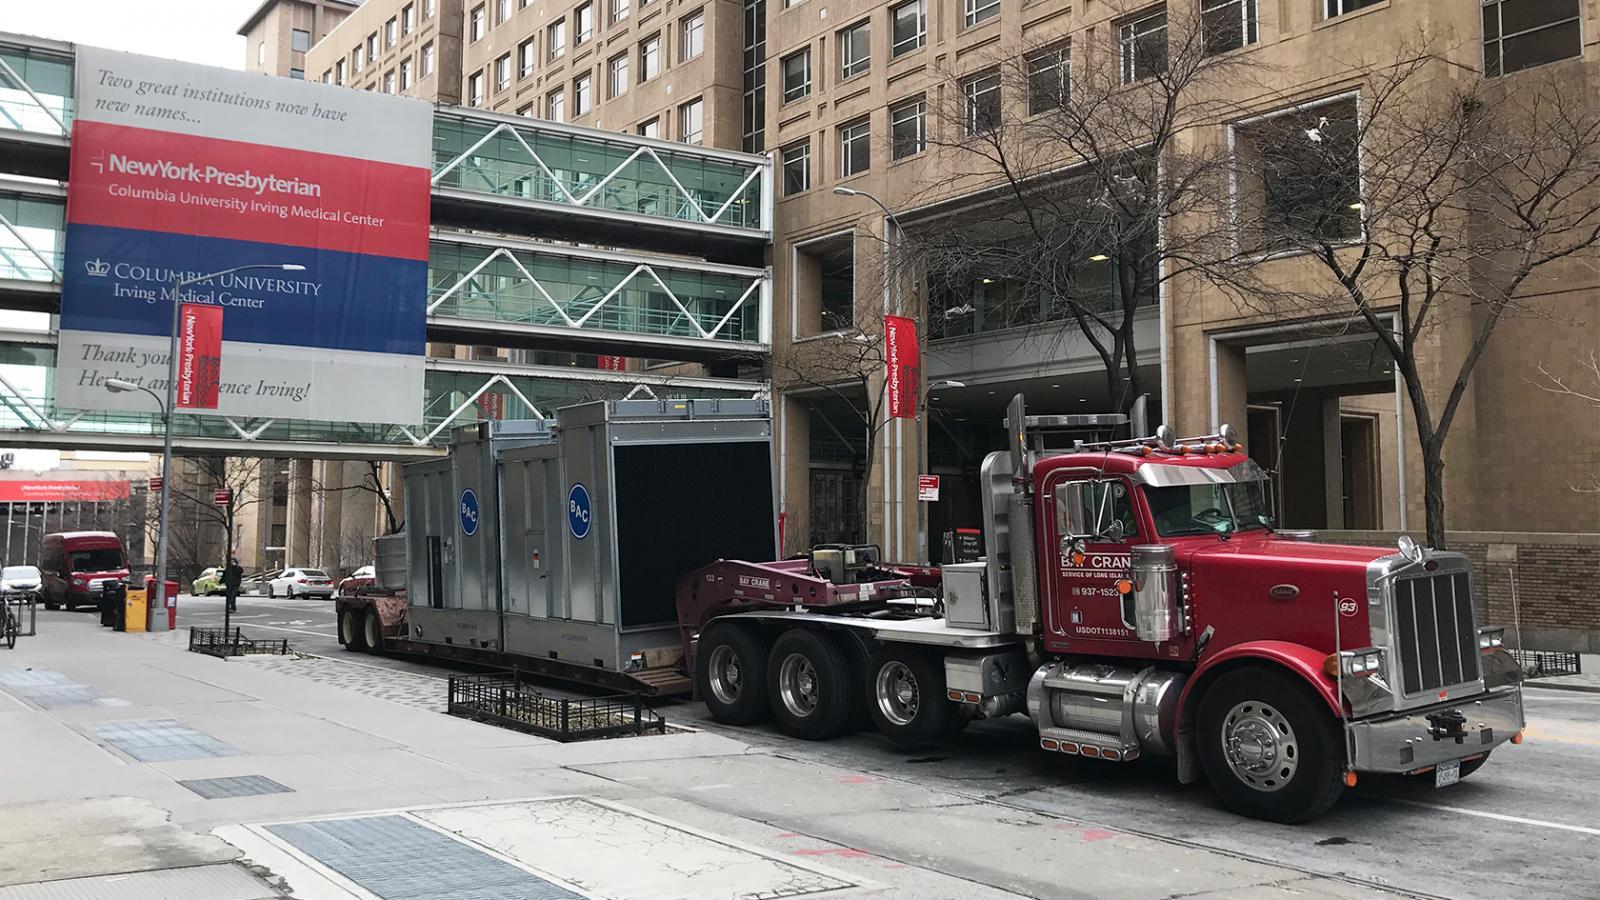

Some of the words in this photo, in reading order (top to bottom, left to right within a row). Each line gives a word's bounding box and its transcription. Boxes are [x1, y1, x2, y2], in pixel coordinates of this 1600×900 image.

[98, 68, 134, 89] Two
[135, 80, 179, 96] great
[182, 81, 272, 111] institutions
[275, 101, 309, 116] now
[311, 102, 348, 122] have
[95, 98, 130, 113] new
[134, 103, 201, 123] names...
[109, 153, 321, 198] NewYork-Presbyterian
[108, 183, 176, 203] Columbia
[180, 191, 249, 214] University
[251, 199, 288, 219] Irving
[291, 205, 341, 222] Medical
[343, 211, 385, 227] Center
[113, 282, 156, 304] Irving
[160, 286, 214, 304] Medical
[219, 291, 265, 308] Center
[220, 272, 322, 296] UNIVERSITY
[82, 343, 137, 364] Thank
[147, 379, 179, 391] an
[256, 380, 312, 402] Irving!
[462, 502, 477, 522] BAC
[570, 499, 588, 523] BAC
[1091, 556, 1131, 568] CRAN
[751, 579, 769, 588] CRANE
[1340, 602, 1356, 612] 93
